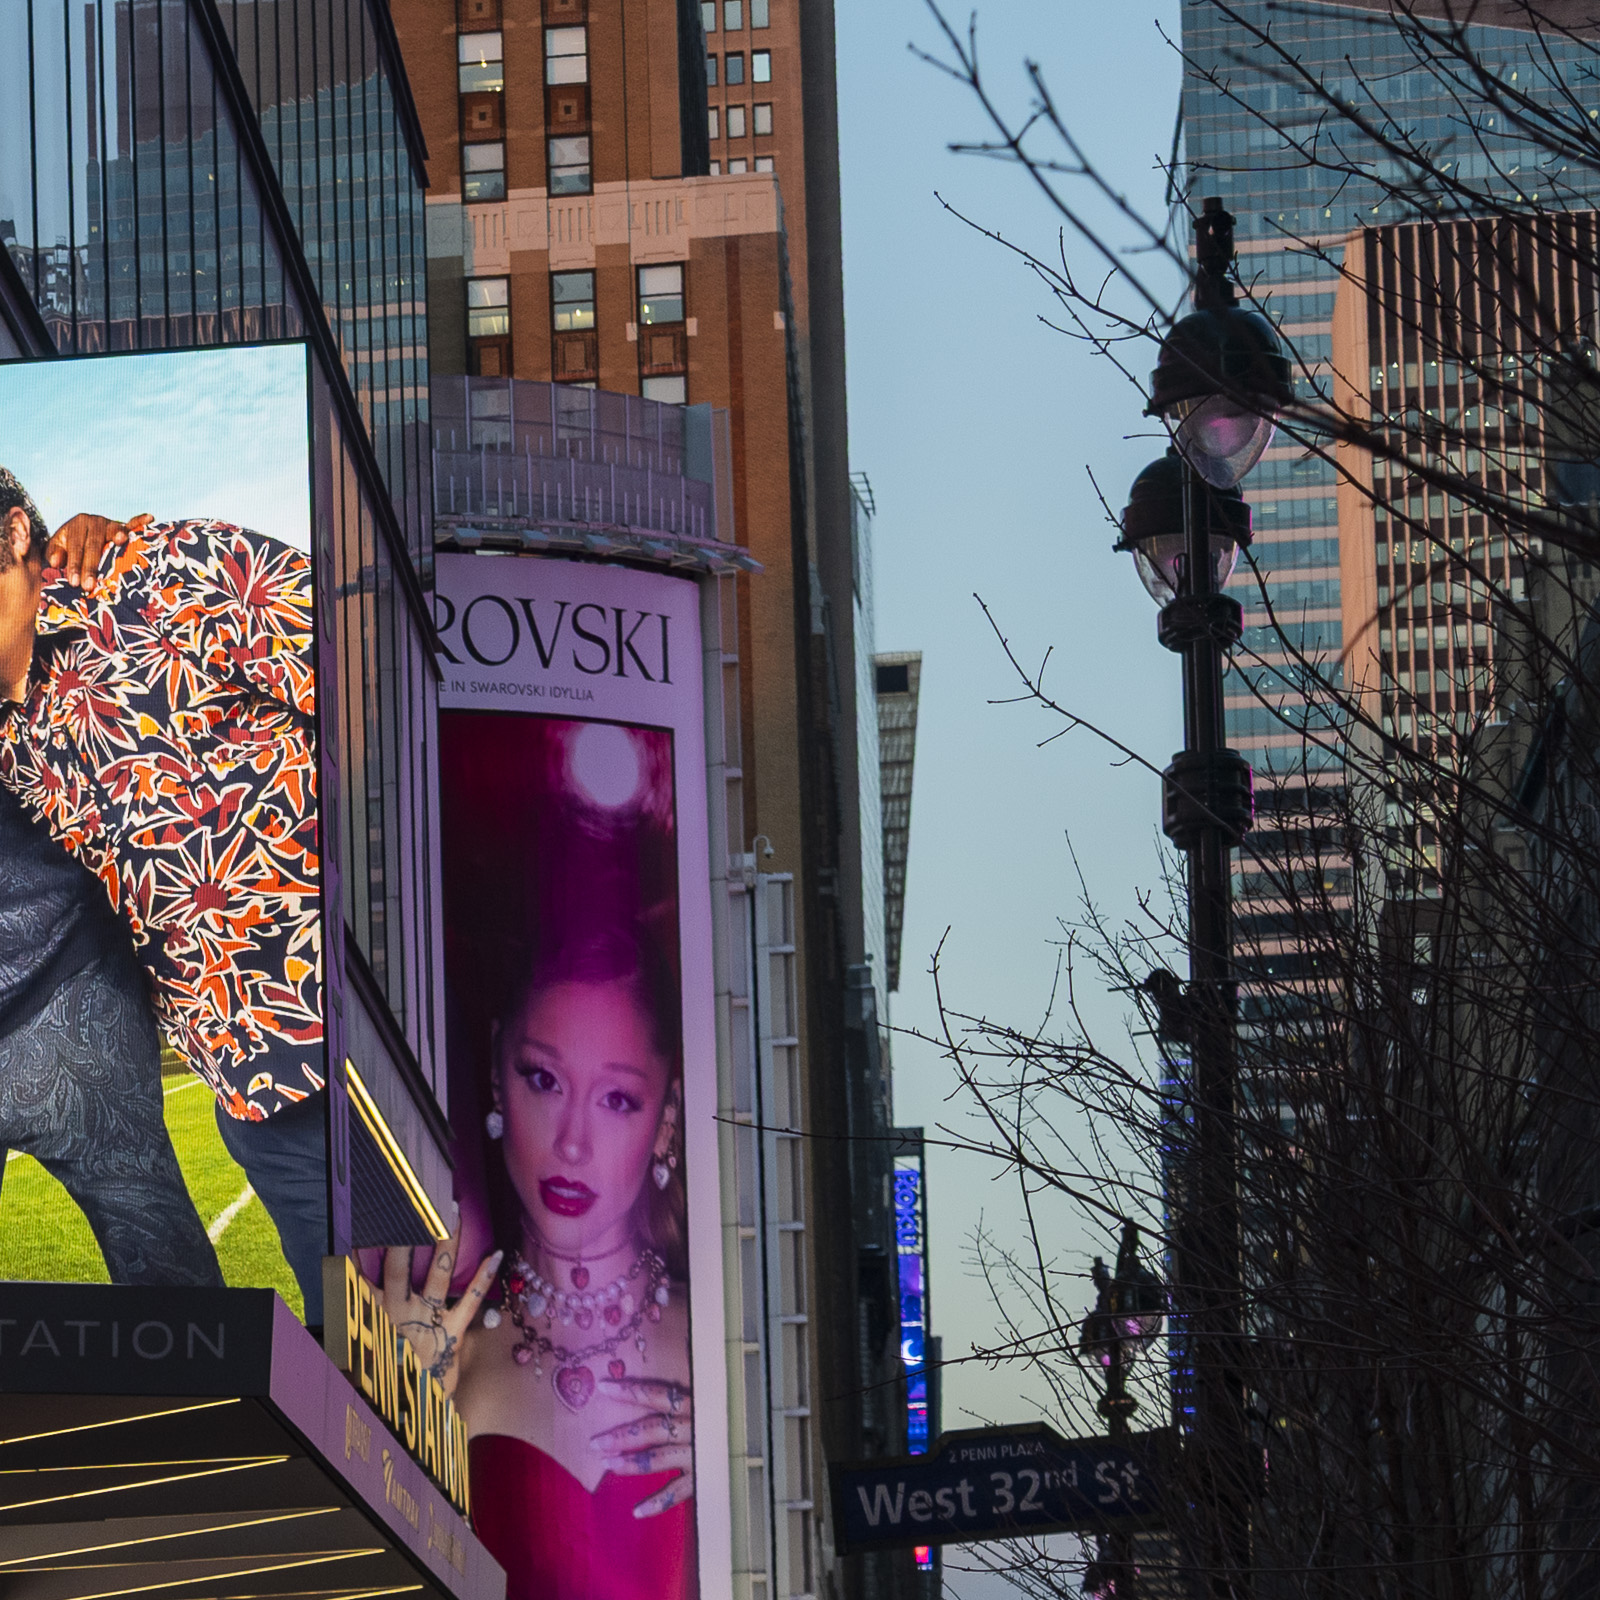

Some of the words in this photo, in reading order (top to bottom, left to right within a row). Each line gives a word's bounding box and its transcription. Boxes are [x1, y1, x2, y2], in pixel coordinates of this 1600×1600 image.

[452, 681, 466, 692] IN
[471, 682, 546, 697] SWAROVSKI
[345, 1254, 400, 1432] PENN
[403, 1337, 470, 1516] STATION
[960, 1446, 998, 1462] PENN
[1001, 1440, 1046, 1457] PLAZA
[857, 1478, 977, 1527] West
[990, 1460, 1078, 1515] 32nd
[1094, 1460, 1140, 1505] St
